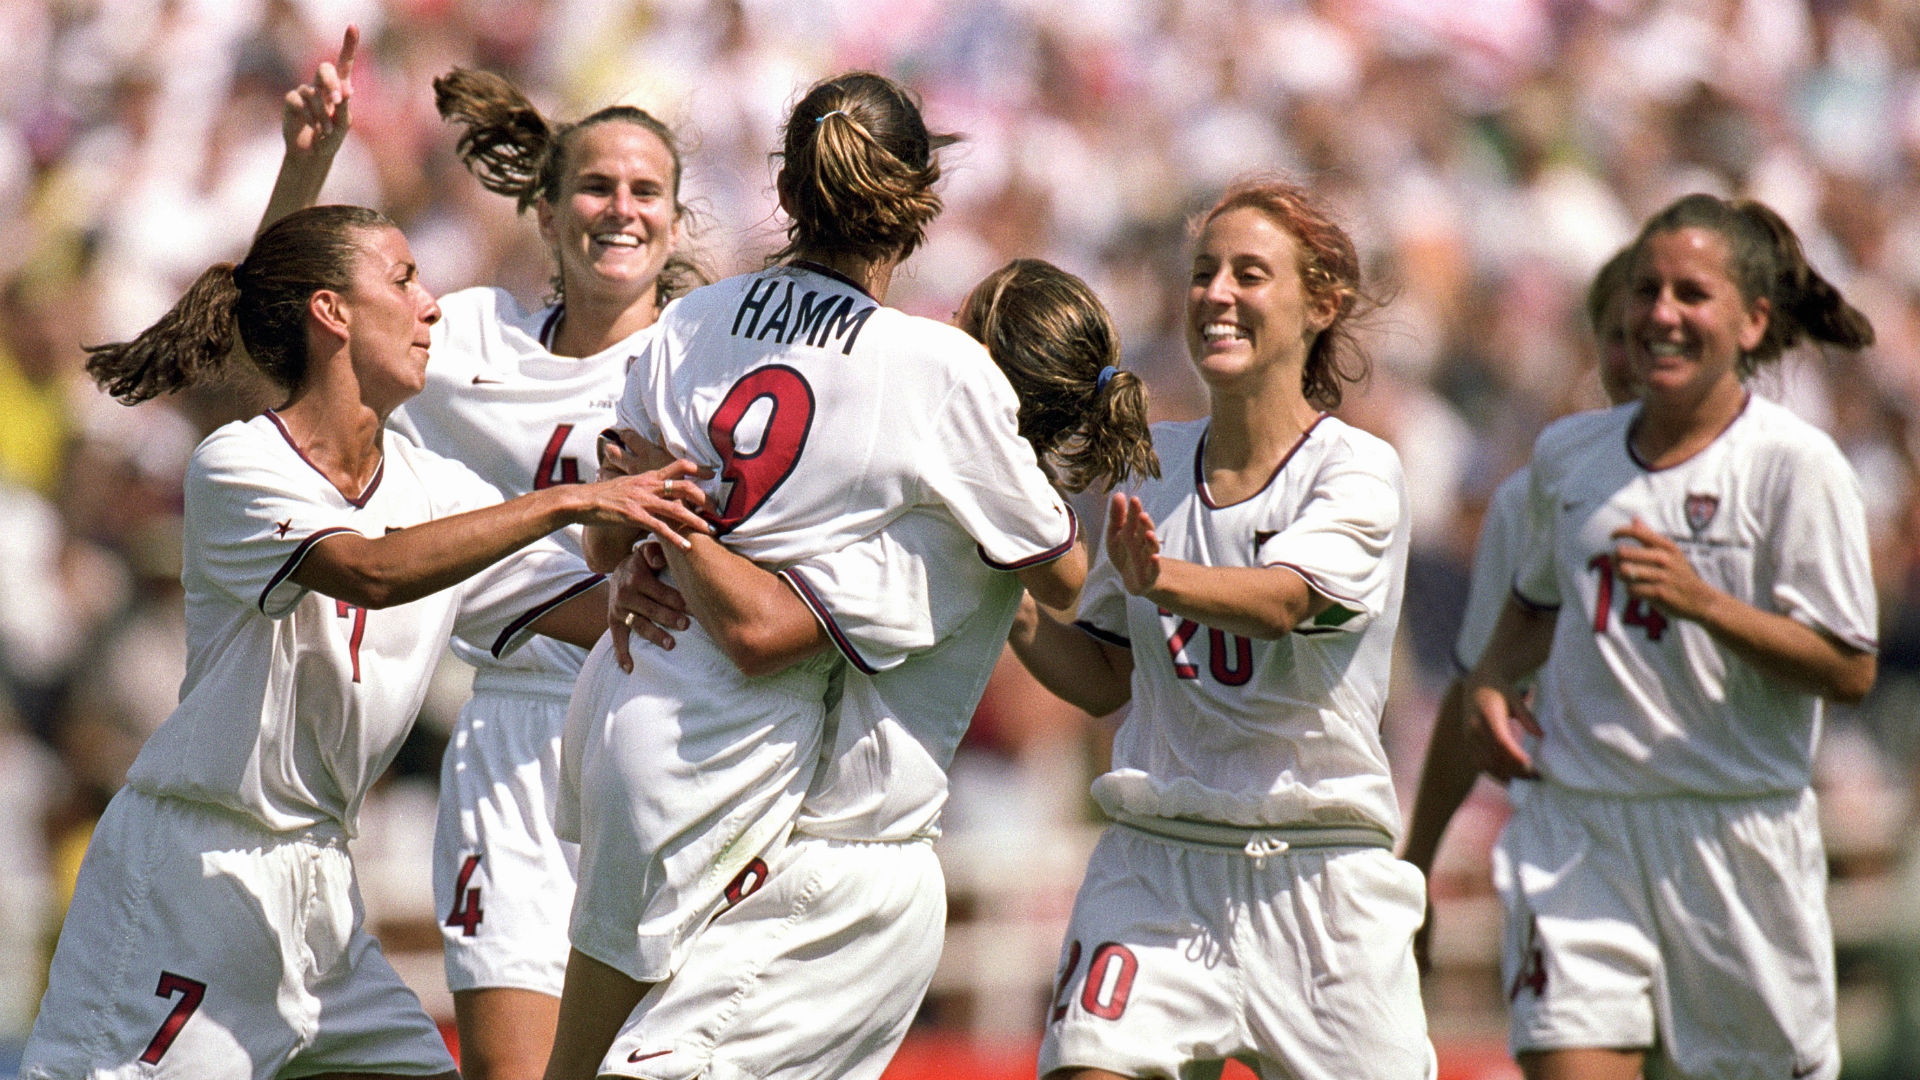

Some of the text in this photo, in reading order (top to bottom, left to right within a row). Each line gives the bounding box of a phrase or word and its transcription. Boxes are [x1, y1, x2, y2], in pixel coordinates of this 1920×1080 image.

[731, 278, 877, 355] HAMM
[533, 424, 586, 491] 4
[704, 364, 816, 539] 9
[335, 600, 367, 684] 7
[445, 855, 484, 936] 4
[138, 970, 207, 1066] 7
